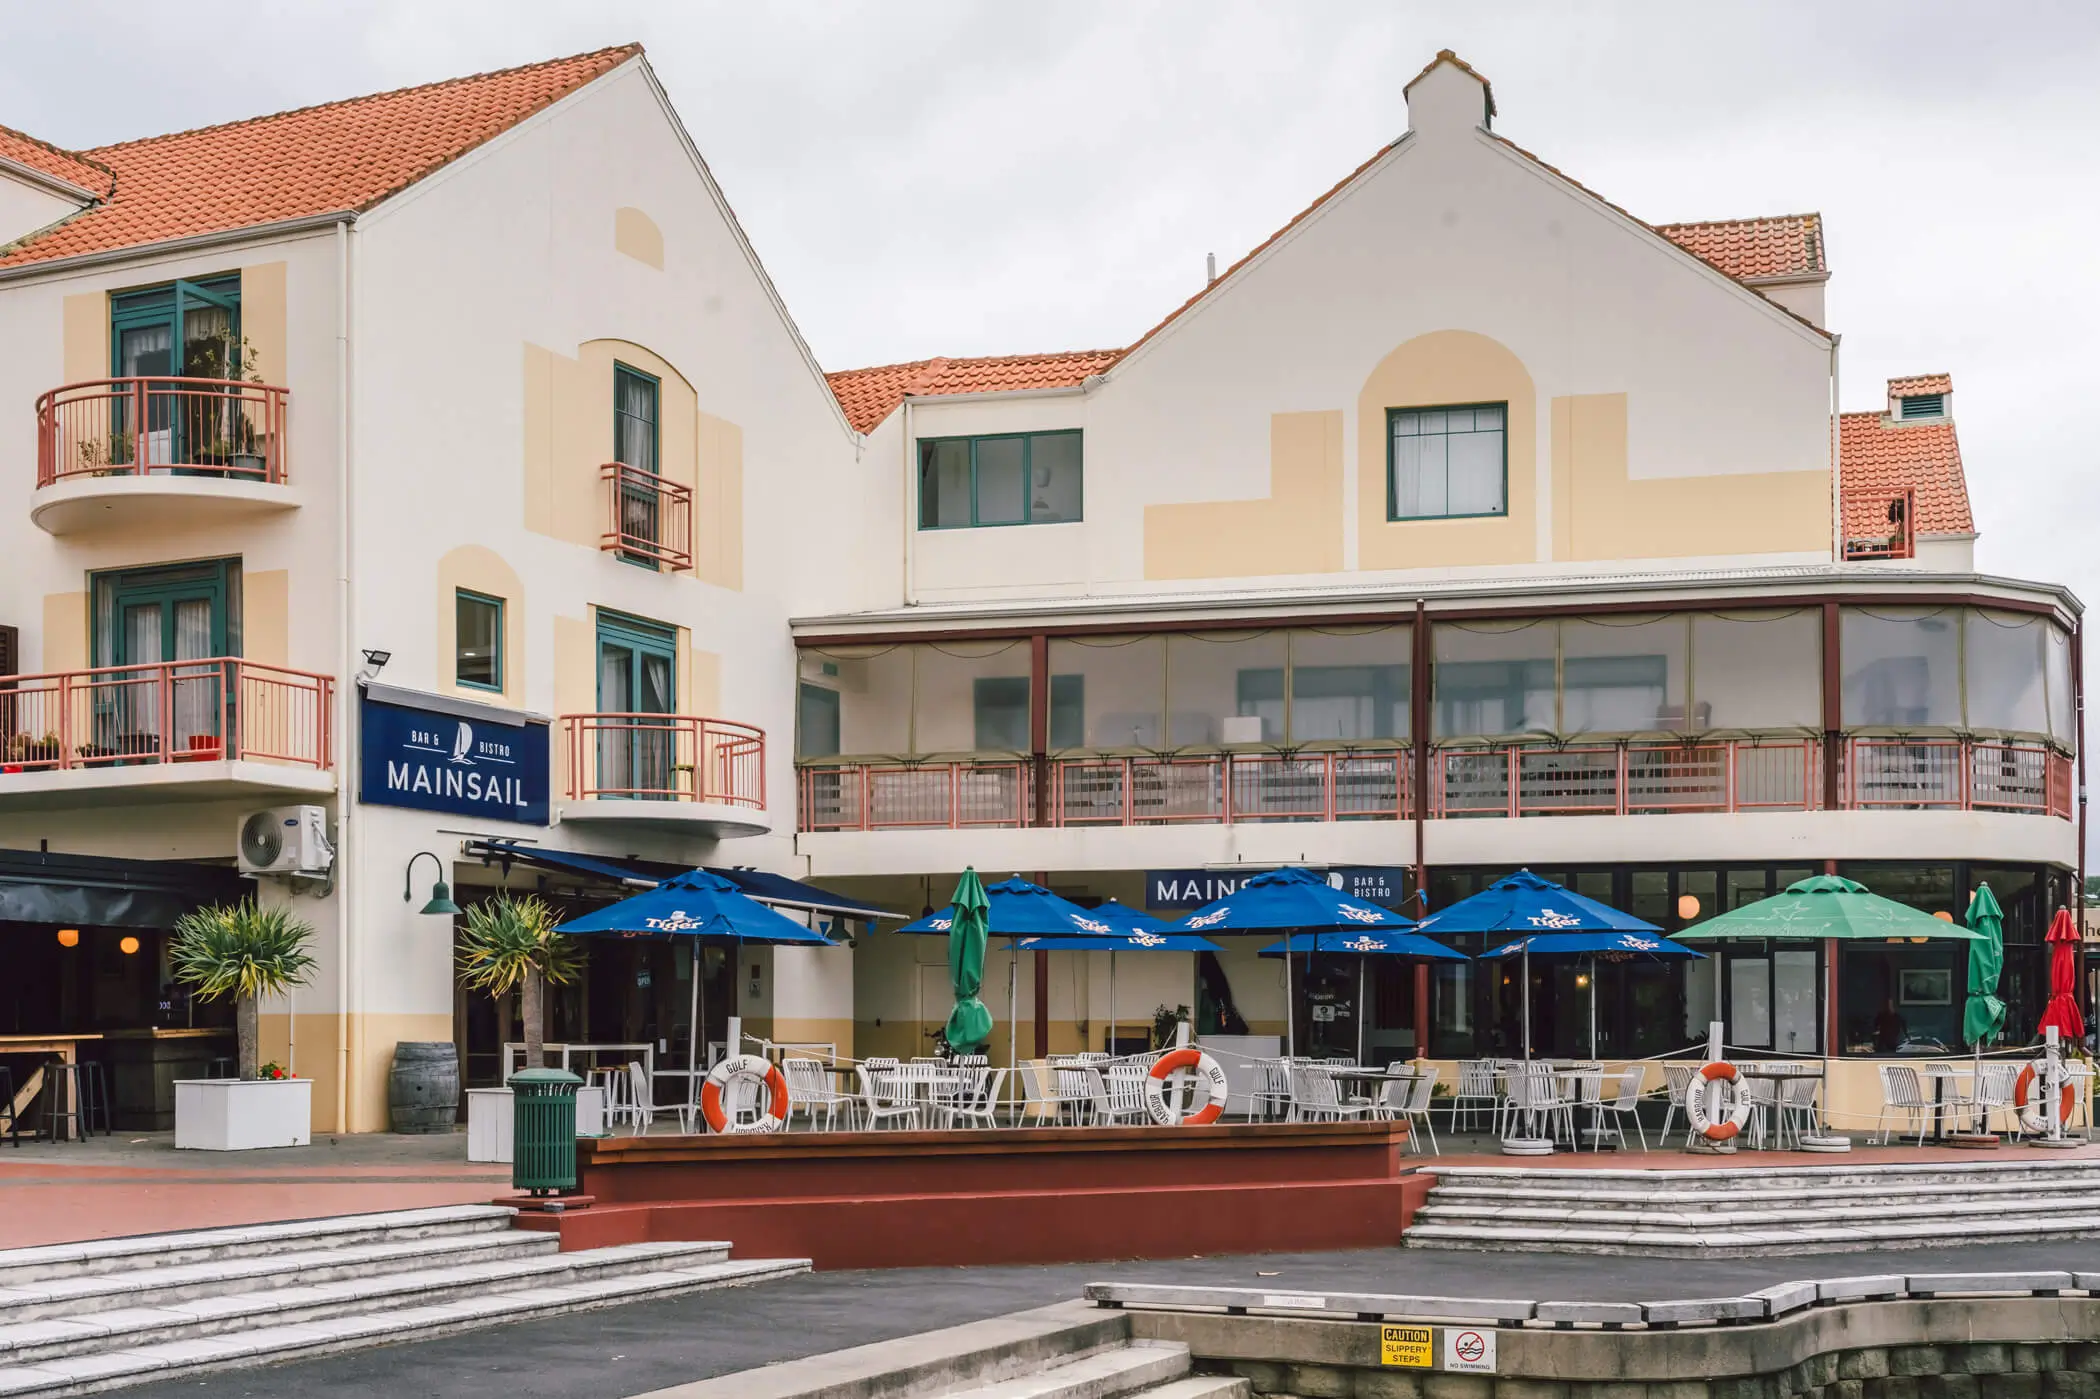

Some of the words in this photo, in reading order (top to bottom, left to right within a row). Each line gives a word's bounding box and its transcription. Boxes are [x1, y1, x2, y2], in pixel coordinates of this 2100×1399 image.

[411, 730, 429, 744] BAR
[433, 733, 439, 746] &
[479, 741, 510, 757] BISTRO
[387, 760, 528, 807] MAINSAIL
[1354, 877, 1373, 886] BAR
[1379, 877, 1385, 886] &
[1157, 879, 1251, 901] MAIN
[1354, 888, 1390, 897] BISTRO
[645, 918, 703, 931] Tiger
[928, 919, 953, 931] Tig
[1527, 916, 1581, 928] Tiger
[1343, 941, 1388, 951] Tiger
[725, 1059, 748, 1074] GULF
[1209, 1066, 1225, 1085] GULF
[1386, 1329, 1428, 1341] CAUTION
[1386, 1345, 1427, 1353] SLIPPERY
[1392, 1355, 1420, 1363] STEPS
